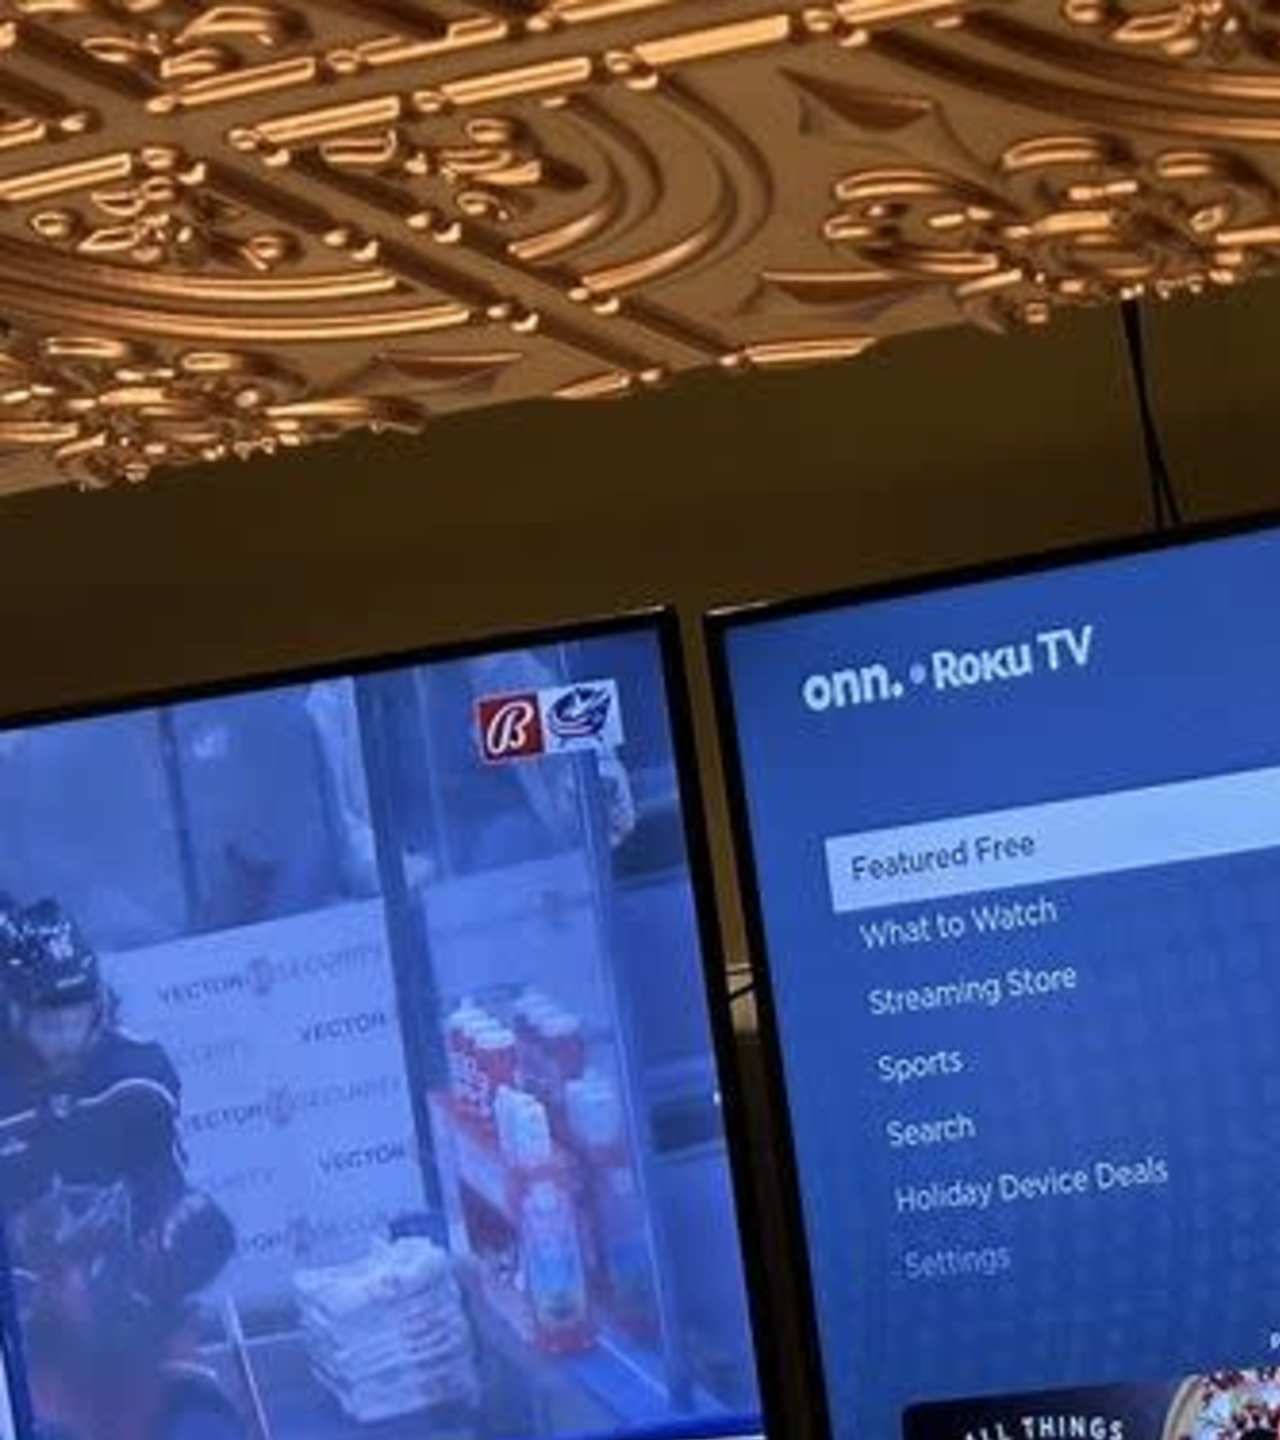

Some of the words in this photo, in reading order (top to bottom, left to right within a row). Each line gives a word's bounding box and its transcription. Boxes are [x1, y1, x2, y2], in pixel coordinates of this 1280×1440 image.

[803, 661, 903, 711] onn.
[932, 643, 1033, 690] Roku
[1037, 625, 1093, 671] TV
[850, 845, 969, 882] Featured
[974, 832, 1036, 864] Free
[859, 916, 931, 950] What
[935, 910, 966, 939] to
[970, 898, 1059, 935] Watch
[868, 973, 1001, 1017] Streaming
[1006, 962, 1078, 996] Store
[877, 1050, 965, 1084] Sports
[885, 1113, 977, 1148] Search
[895, 1179, 993, 1213] Holiday
[998, 1167, 1089, 1202] Device
[1094, 1156, 1170, 1190] Deals
[904, 1246, 1012, 1280] Settings
